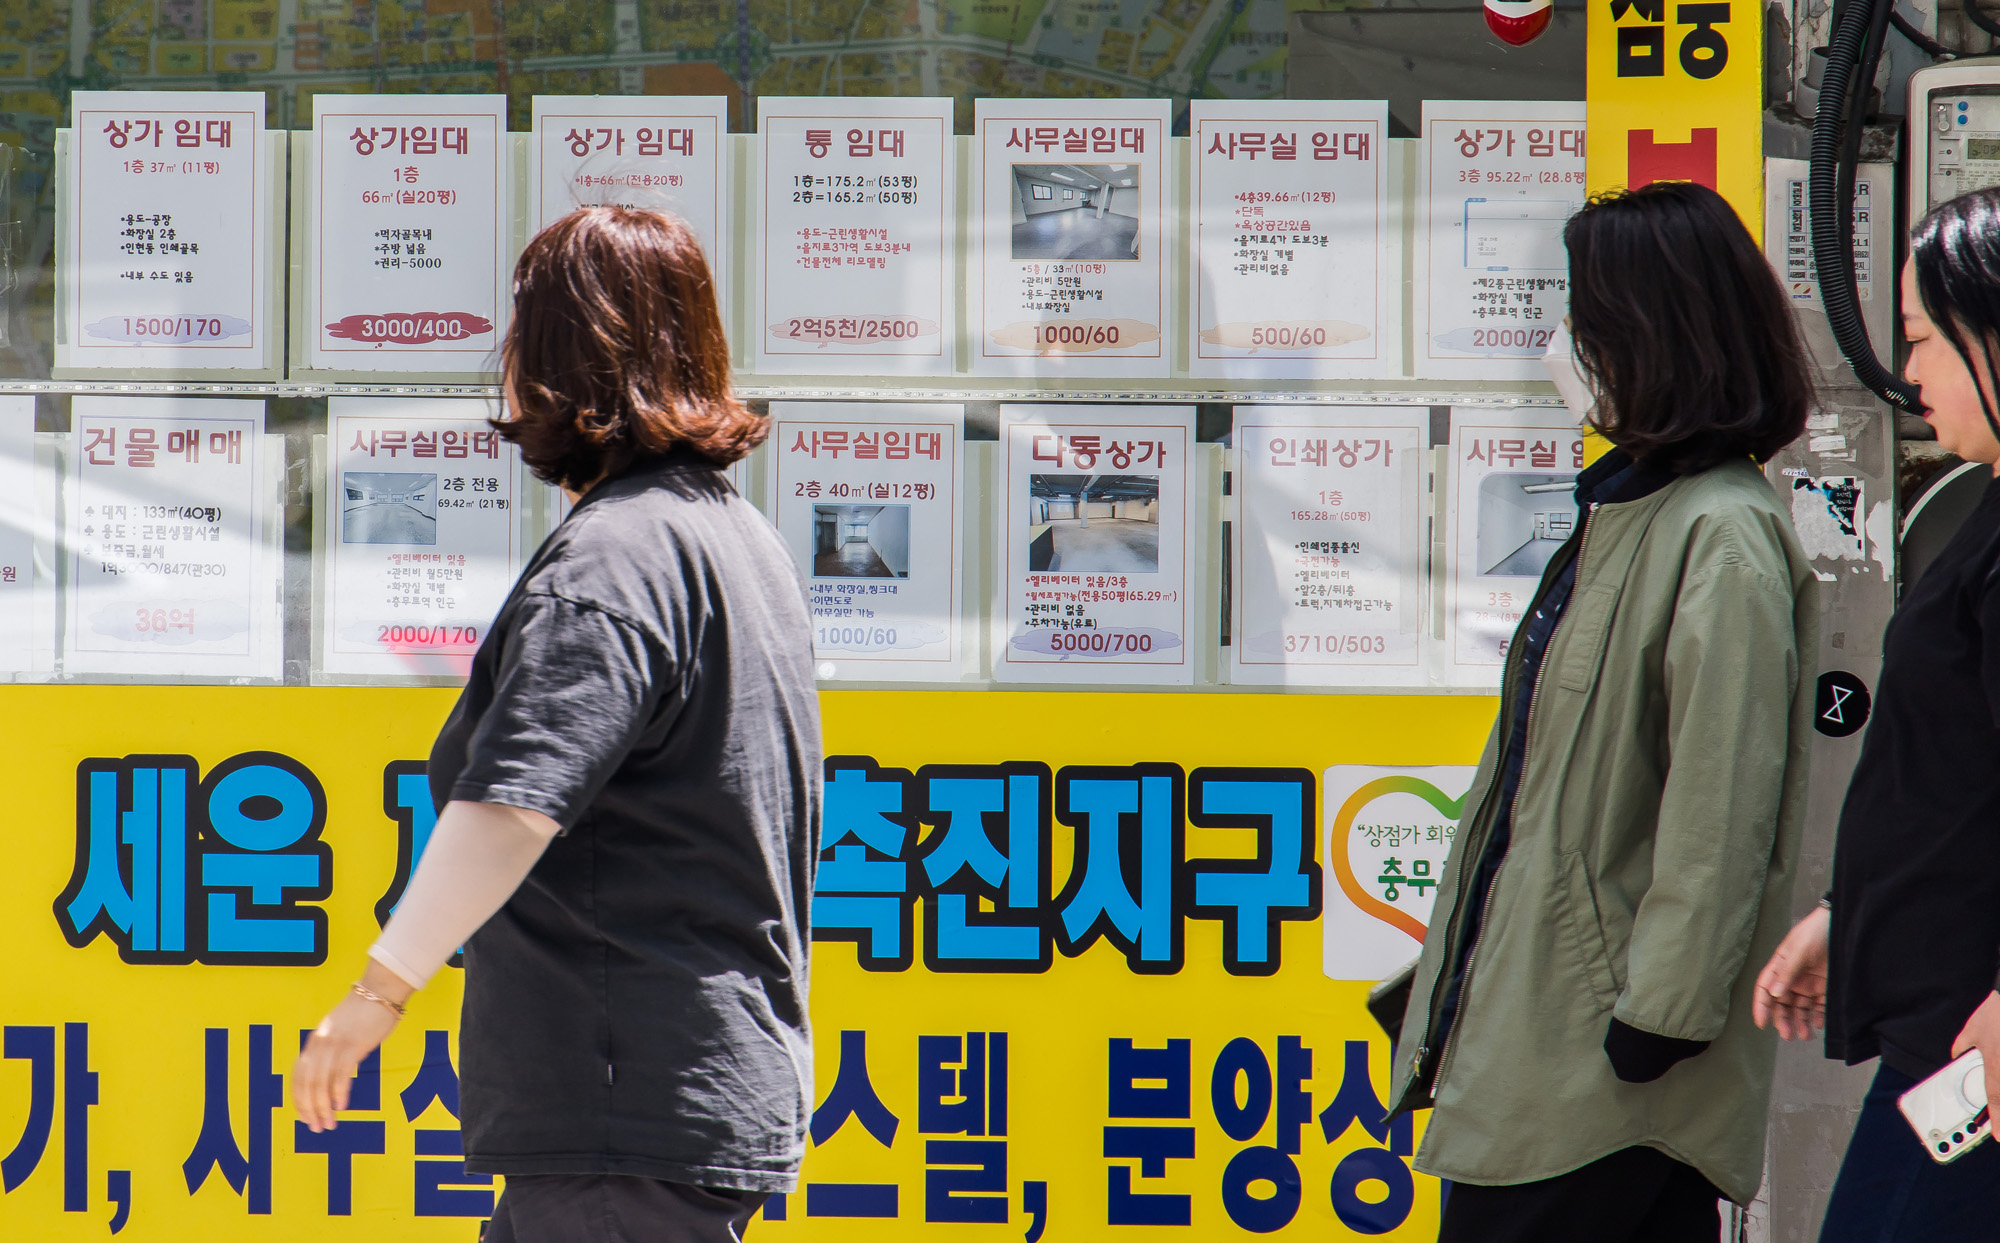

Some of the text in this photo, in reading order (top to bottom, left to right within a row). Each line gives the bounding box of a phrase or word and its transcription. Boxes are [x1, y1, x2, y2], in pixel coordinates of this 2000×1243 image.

[103, 119, 231, 148] 상가 임대
[350, 126, 468, 156] 상가임대
[564, 128, 693, 157] 상가 임대
[805, 129, 904, 158] 통 임대
[1006, 127, 1145, 153] 사무실임대
[1208, 132, 1370, 160] 사무실 임대
[1454, 129, 1585, 158] 상가 임대
[123, 159, 144, 174] 1층
[182, 161, 220, 174] (11평)
[394, 166, 419, 183] 1층
[1459, 169, 1481, 183] 3층
[1242, 206, 1264, 217] 단독
[126, 214, 171, 226] 용도-공장
[1242, 220, 1311, 231] 옥상공간있음
[126, 229, 176, 240] 화장실 2층
[380, 229, 432, 240] 먹자골목내
[802, 228, 888, 240] 용도-근린생활시설
[1239, 235, 1329, 247] 을지로4가 도보3분
[126, 243, 199, 254] 인현동 인쇄골목
[380, 243, 426, 255] 주방 넓음
[802, 242, 911, 254] 을지로3가역 도보3분내
[1239, 249, 1294, 261] 화장실 개별
[380, 258, 442, 269] 권리-5000
[802, 257, 886, 269] 건물전체 리모델링
[1027, 264, 1041, 275] 5층
[1239, 264, 1289, 275] 관리비없음
[126, 271, 194, 283] 내부 수도 있음
[1026, 277, 1081, 287] 관리비 5만원
[1478, 279, 1566, 290] 제2종근린생활시설
[1026, 290, 1103, 300] 용도-근린생활시설
[1478, 293, 1533, 304] 화장실 개별
[1026, 302, 1070, 313] 내부화장실
[1478, 307, 1543, 319] 충무로역 인근
[124, 318, 221, 336] 1500/170
[361, 318, 461, 338] 3000/400
[789, 319, 919, 339] 2억5천/2500
[1034, 326, 1120, 344] 1000/60
[1252, 327, 1326, 346] 500/60
[84, 427, 242, 467] 건물매매
[350, 430, 499, 459] 사무실임대
[791, 431, 941, 460] 사무실임대
[1032, 435, 1166, 470] 다동상가
[1269, 438, 1394, 468] 인쇄상가
[1467, 439, 1556, 468] 사무실
[444, 477, 499, 492] 2층 전용
[795, 481, 822, 498] 2층
[479, 499, 509, 509] (21평)
[1319, 490, 1343, 506] 1층
[102, 506, 127, 520] 대지
[102, 524, 126, 539] 용도
[142, 525, 220, 541] 근린생활시설
[1300, 541, 1360, 554] 인쇄업종출신
[392, 554, 466, 566] 엘리베이터 있음
[1300, 556, 1340, 568] 국전가능
[392, 568, 463, 580] 관리비 월5만원
[1300, 570, 1350, 582] 엘리베이터
[392, 582, 445, 594] 화장실 개별
[1030, 576, 1128, 588] 엘리베이터 있음/3층
[814, 584, 833, 594] 내부
[436, 597, 455, 609] 인근
[814, 597, 852, 605] 이면도로
[1300, 599, 1393, 611] 트럭,지게차접근가능
[1488, 592, 1512, 607] 3층
[814, 608, 875, 618] 사무실만 가능
[1030, 604, 1085, 616] 관리비 없음
[135, 608, 194, 635] 36억
[1030, 618, 1098, 630] 주차가능(유료)
[378, 625, 477, 644] 2000/170
[818, 627, 897, 646] 1000/60
[1051, 634, 1152, 653] 5000/700
[1285, 635, 1385, 654] 3710/503
[53, 751, 333, 966] 세운
[1378, 857, 1447, 901] 충무
